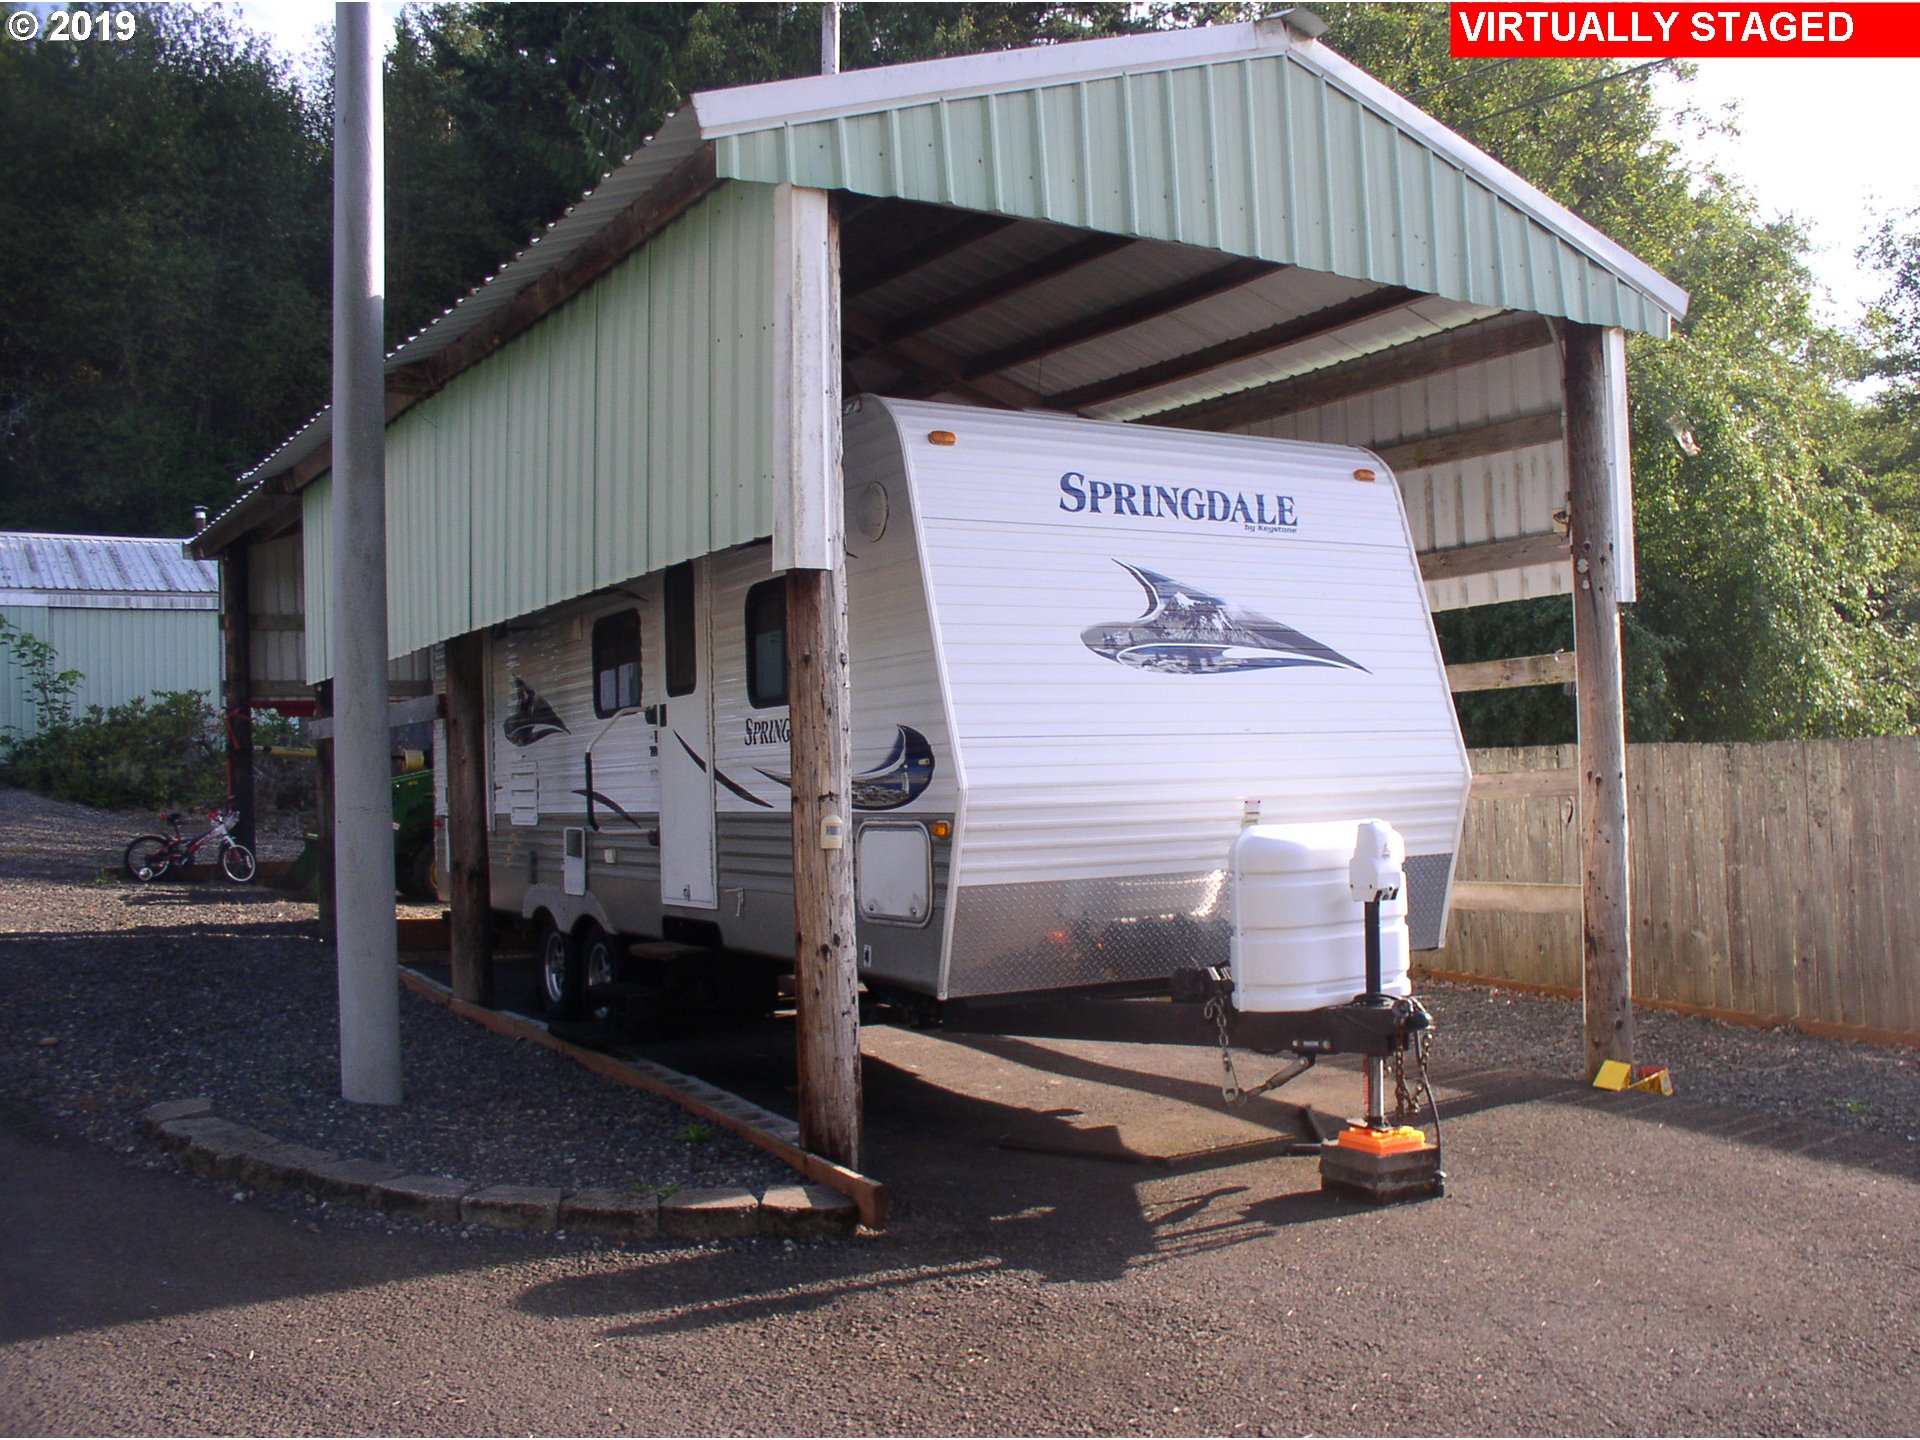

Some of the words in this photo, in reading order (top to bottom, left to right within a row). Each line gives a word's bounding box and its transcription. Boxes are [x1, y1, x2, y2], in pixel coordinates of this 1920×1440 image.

[1059, 471, 1298, 527] SPRINGDALE
[1244, 524, 1256, 533] by
[1258, 524, 1297, 534] Keystone
